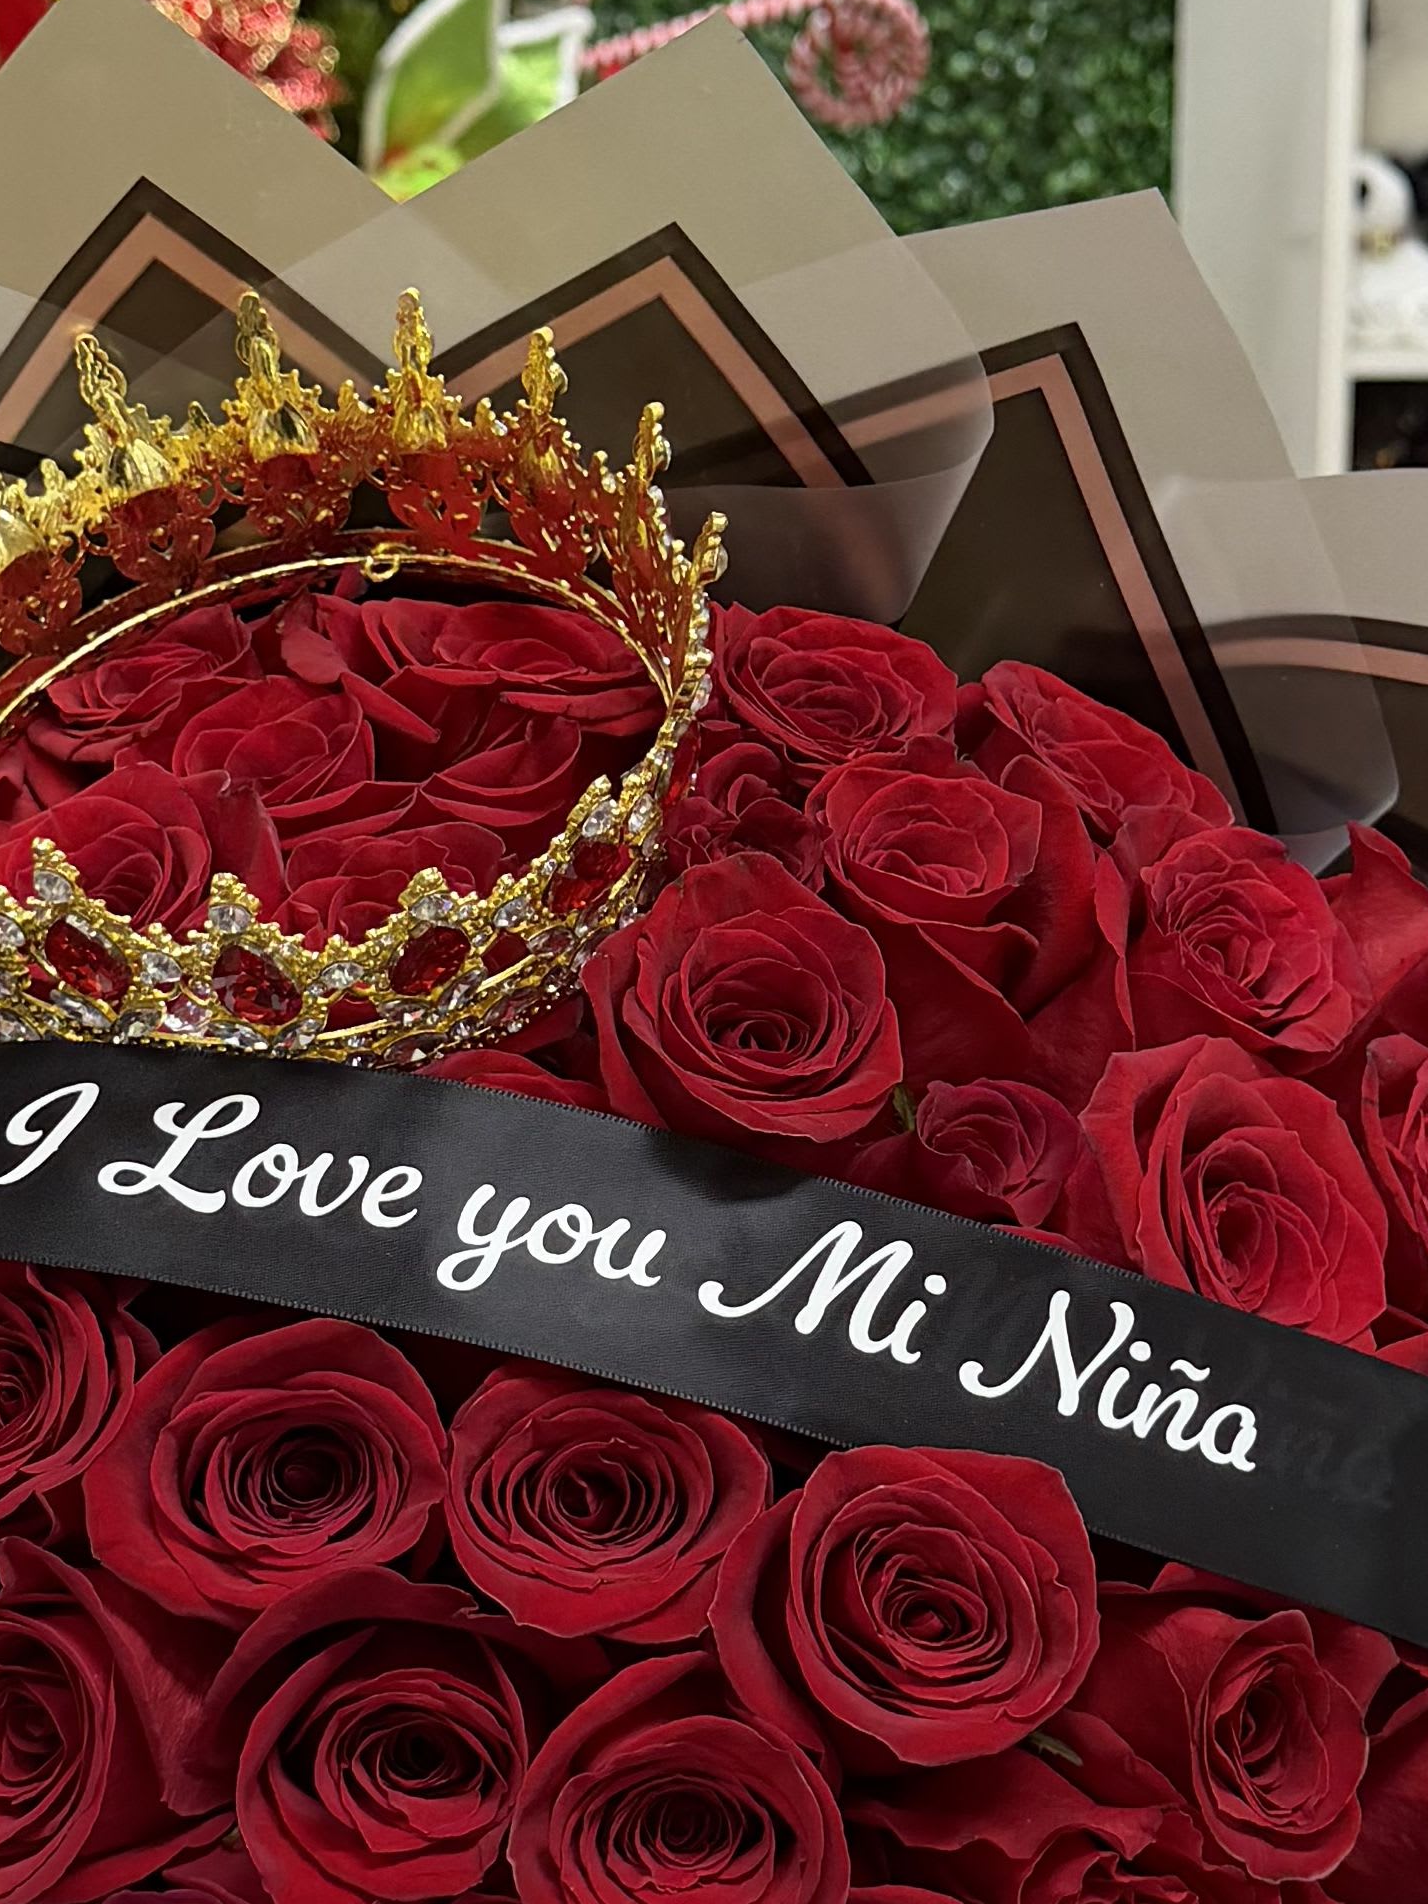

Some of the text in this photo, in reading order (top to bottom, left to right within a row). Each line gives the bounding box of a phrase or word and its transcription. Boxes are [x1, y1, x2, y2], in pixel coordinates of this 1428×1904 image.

[97, 1094, 423, 1228] Love
[436, 1183, 667, 1292] you
[697, 1220, 948, 1365] Mi
[958, 1289, 1258, 1472] Niña
